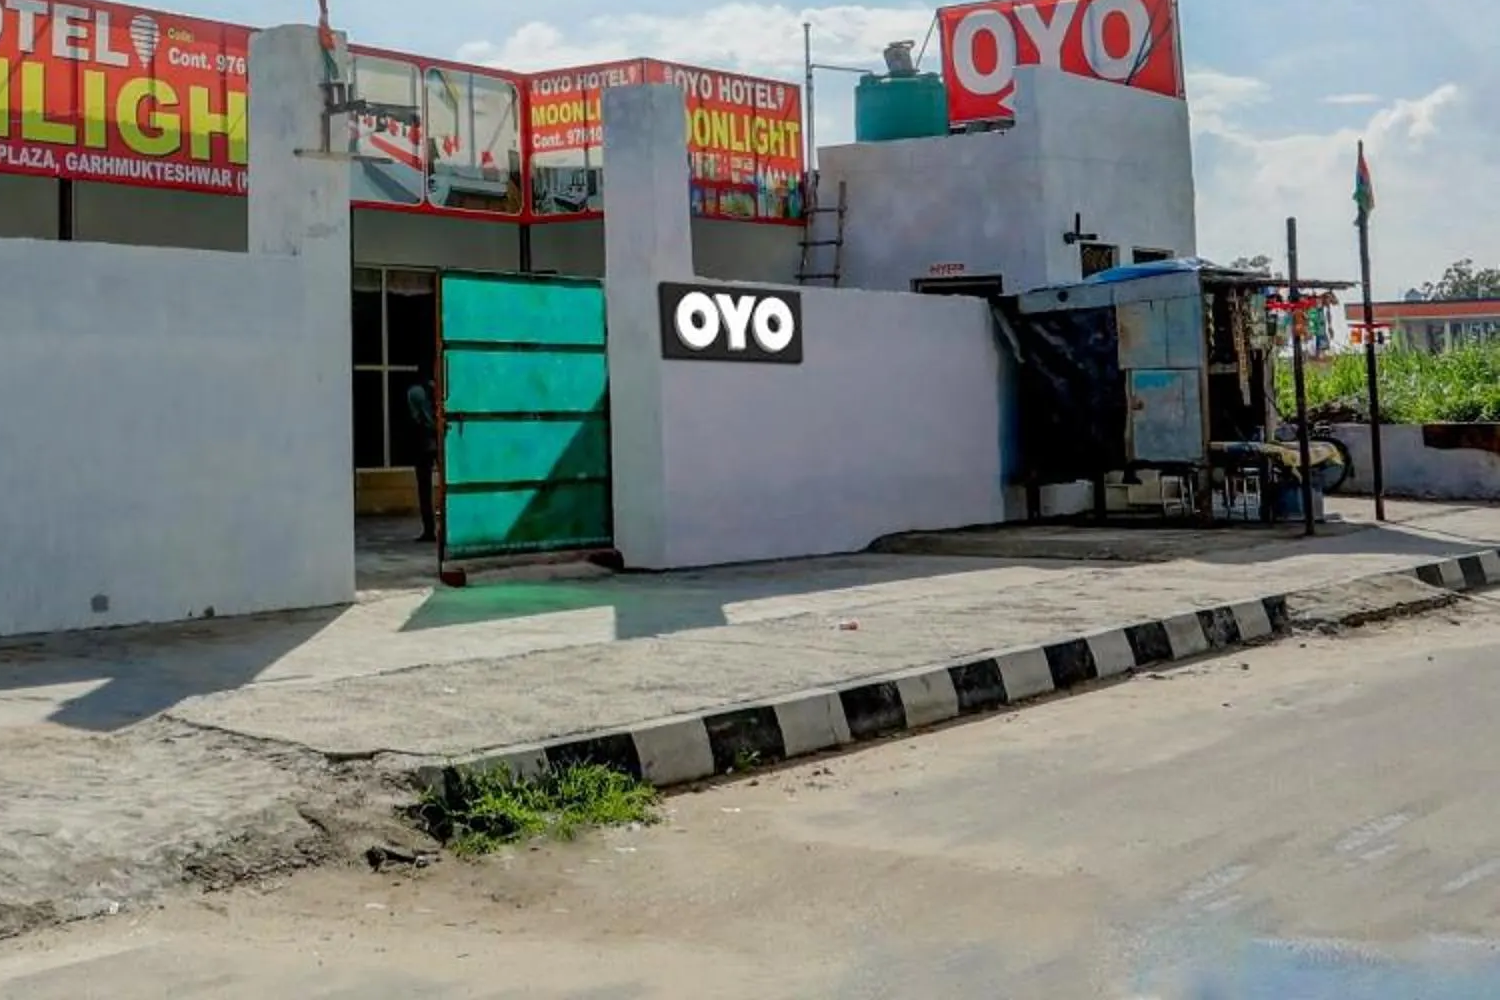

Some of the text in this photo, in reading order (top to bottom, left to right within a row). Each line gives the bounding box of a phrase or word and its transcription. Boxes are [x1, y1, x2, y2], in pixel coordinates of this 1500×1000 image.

[168, 47, 212, 71] Cont.
[541, 69, 628, 97] OYO HOTEL
[673, 69, 778, 110] OYO HOTEL
[65, 151, 233, 189] GARHMUKTESHWAR
[674, 291, 795, 353] OYO
